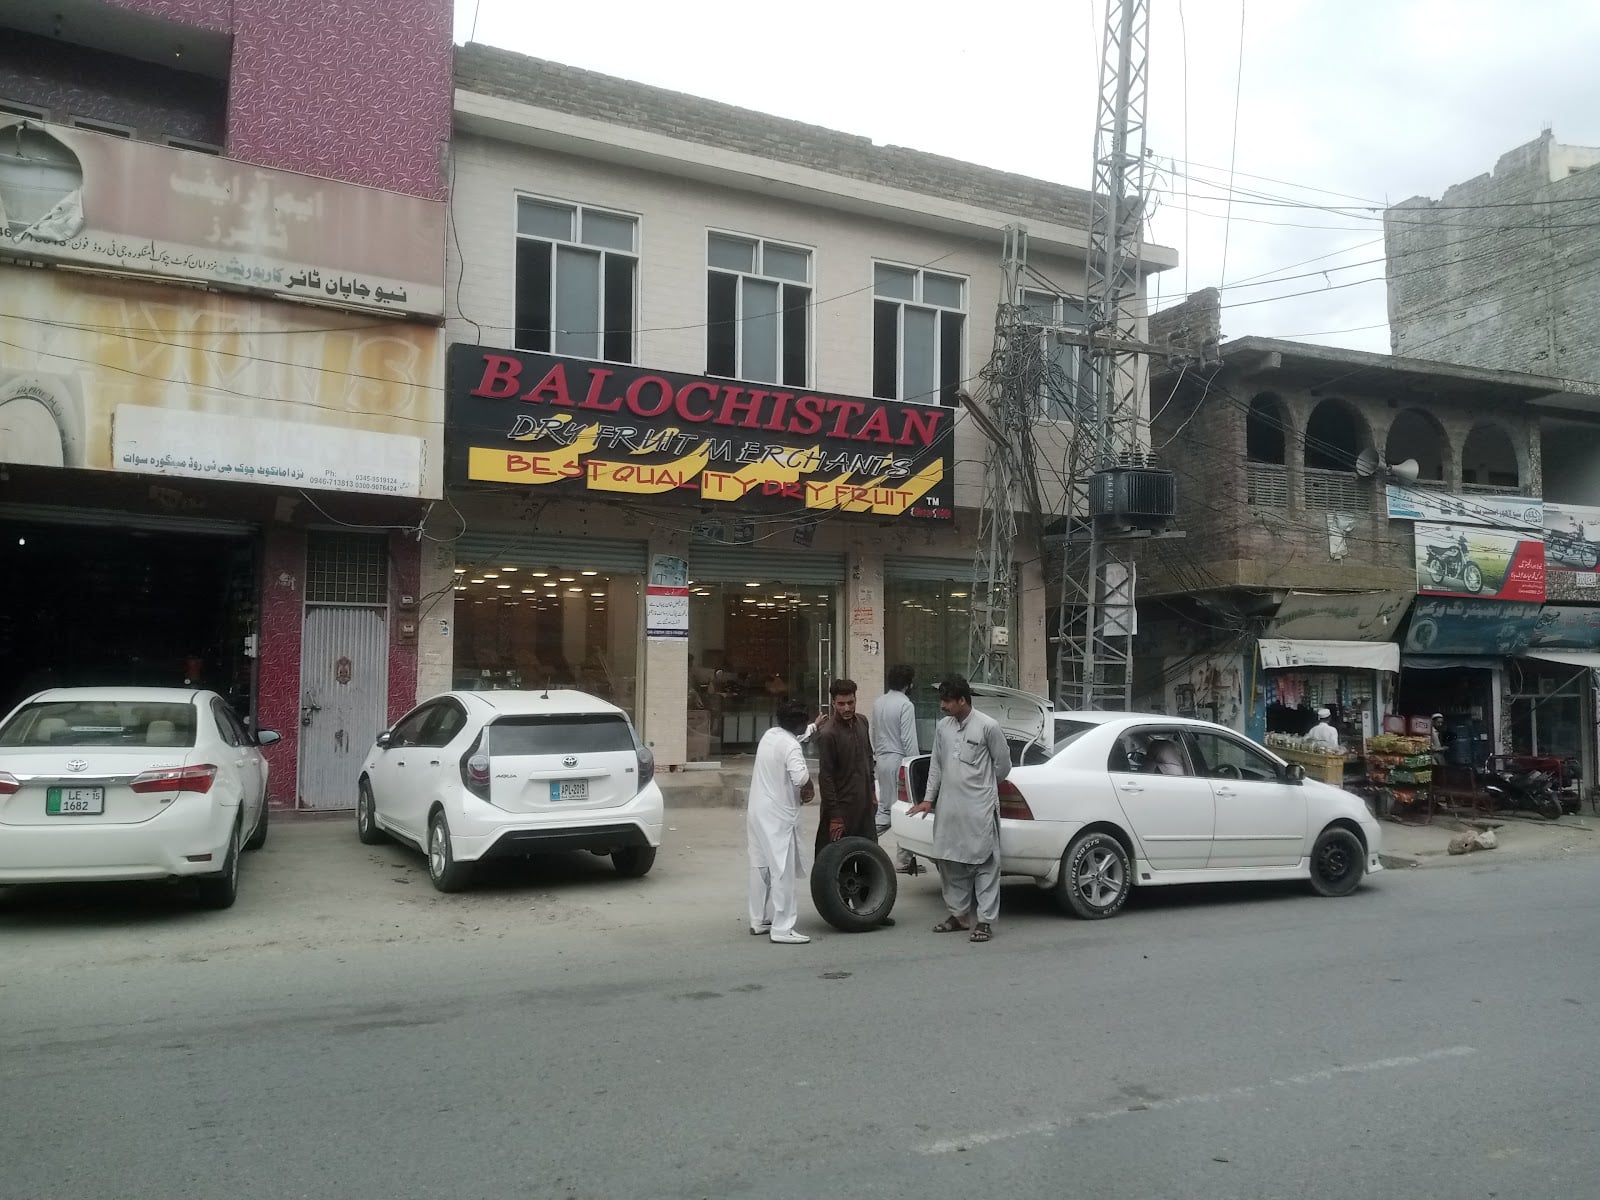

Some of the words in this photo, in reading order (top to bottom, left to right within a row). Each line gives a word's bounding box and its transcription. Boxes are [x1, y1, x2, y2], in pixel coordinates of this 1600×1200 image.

[325, 275, 371, 300] جاپان
[374, 286, 408, 304] نیو
[470, 354, 944, 446] BALOCHISTAN
[507, 414, 588, 447] DRY
[593, 425, 698, 456] FRUIT
[699, 436, 914, 479] MERCHANTS
[122, 452, 148, 466] سوات
[506, 454, 607, 481] BEST
[612, 465, 758, 496] QUALITY
[762, 479, 828, 499] DRY
[834, 484, 914, 509] FRUIT
[926, 496, 940, 506] TM
[68, 791, 82, 801] LE
[63, 802, 89, 811] 1682
